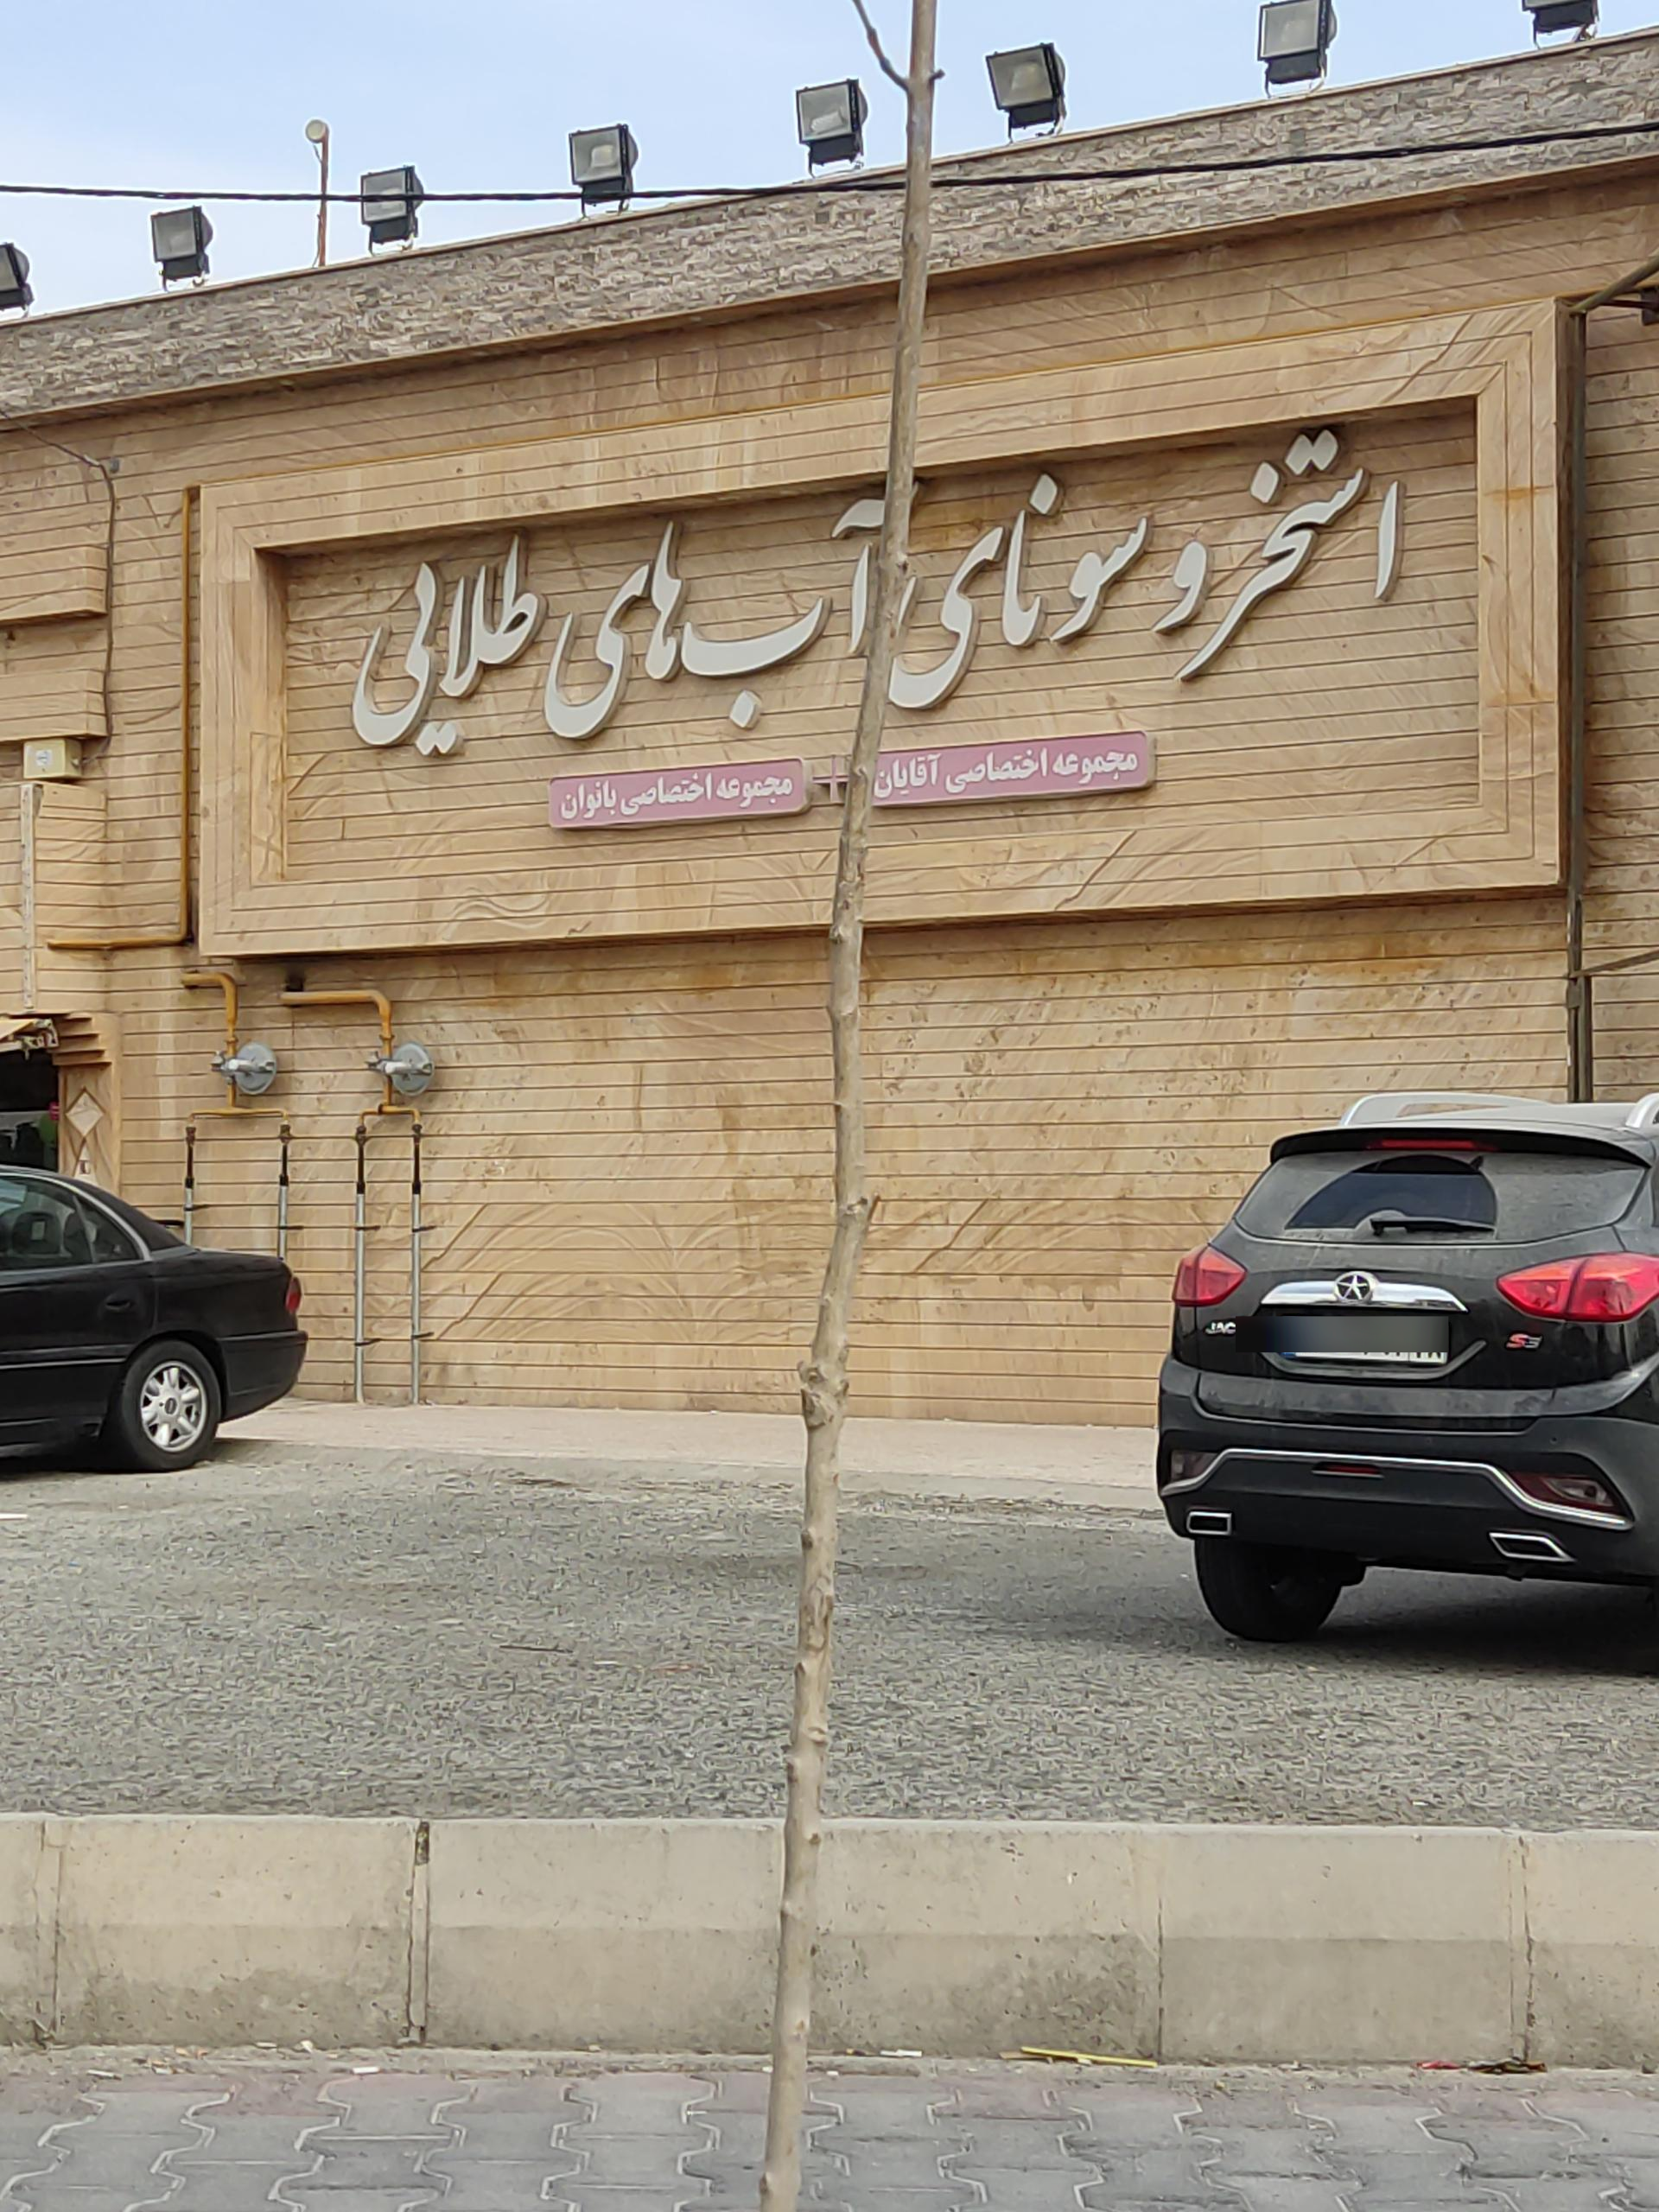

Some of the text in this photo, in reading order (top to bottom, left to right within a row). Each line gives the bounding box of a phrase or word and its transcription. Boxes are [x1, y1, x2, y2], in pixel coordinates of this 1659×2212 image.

[887, 473, 1147, 709] سونای
[1153, 539, 1208, 633] و
[1175, 429, 1399, 682] استخر
[352, 535, 539, 756] طلایی
[561, 772, 793, 819] مجموعه اختصاصی بانوان
[873, 747, 1139, 798] مجموعه اختصاصی آقایان
[1205, 1322, 1236, 1335] JAC
